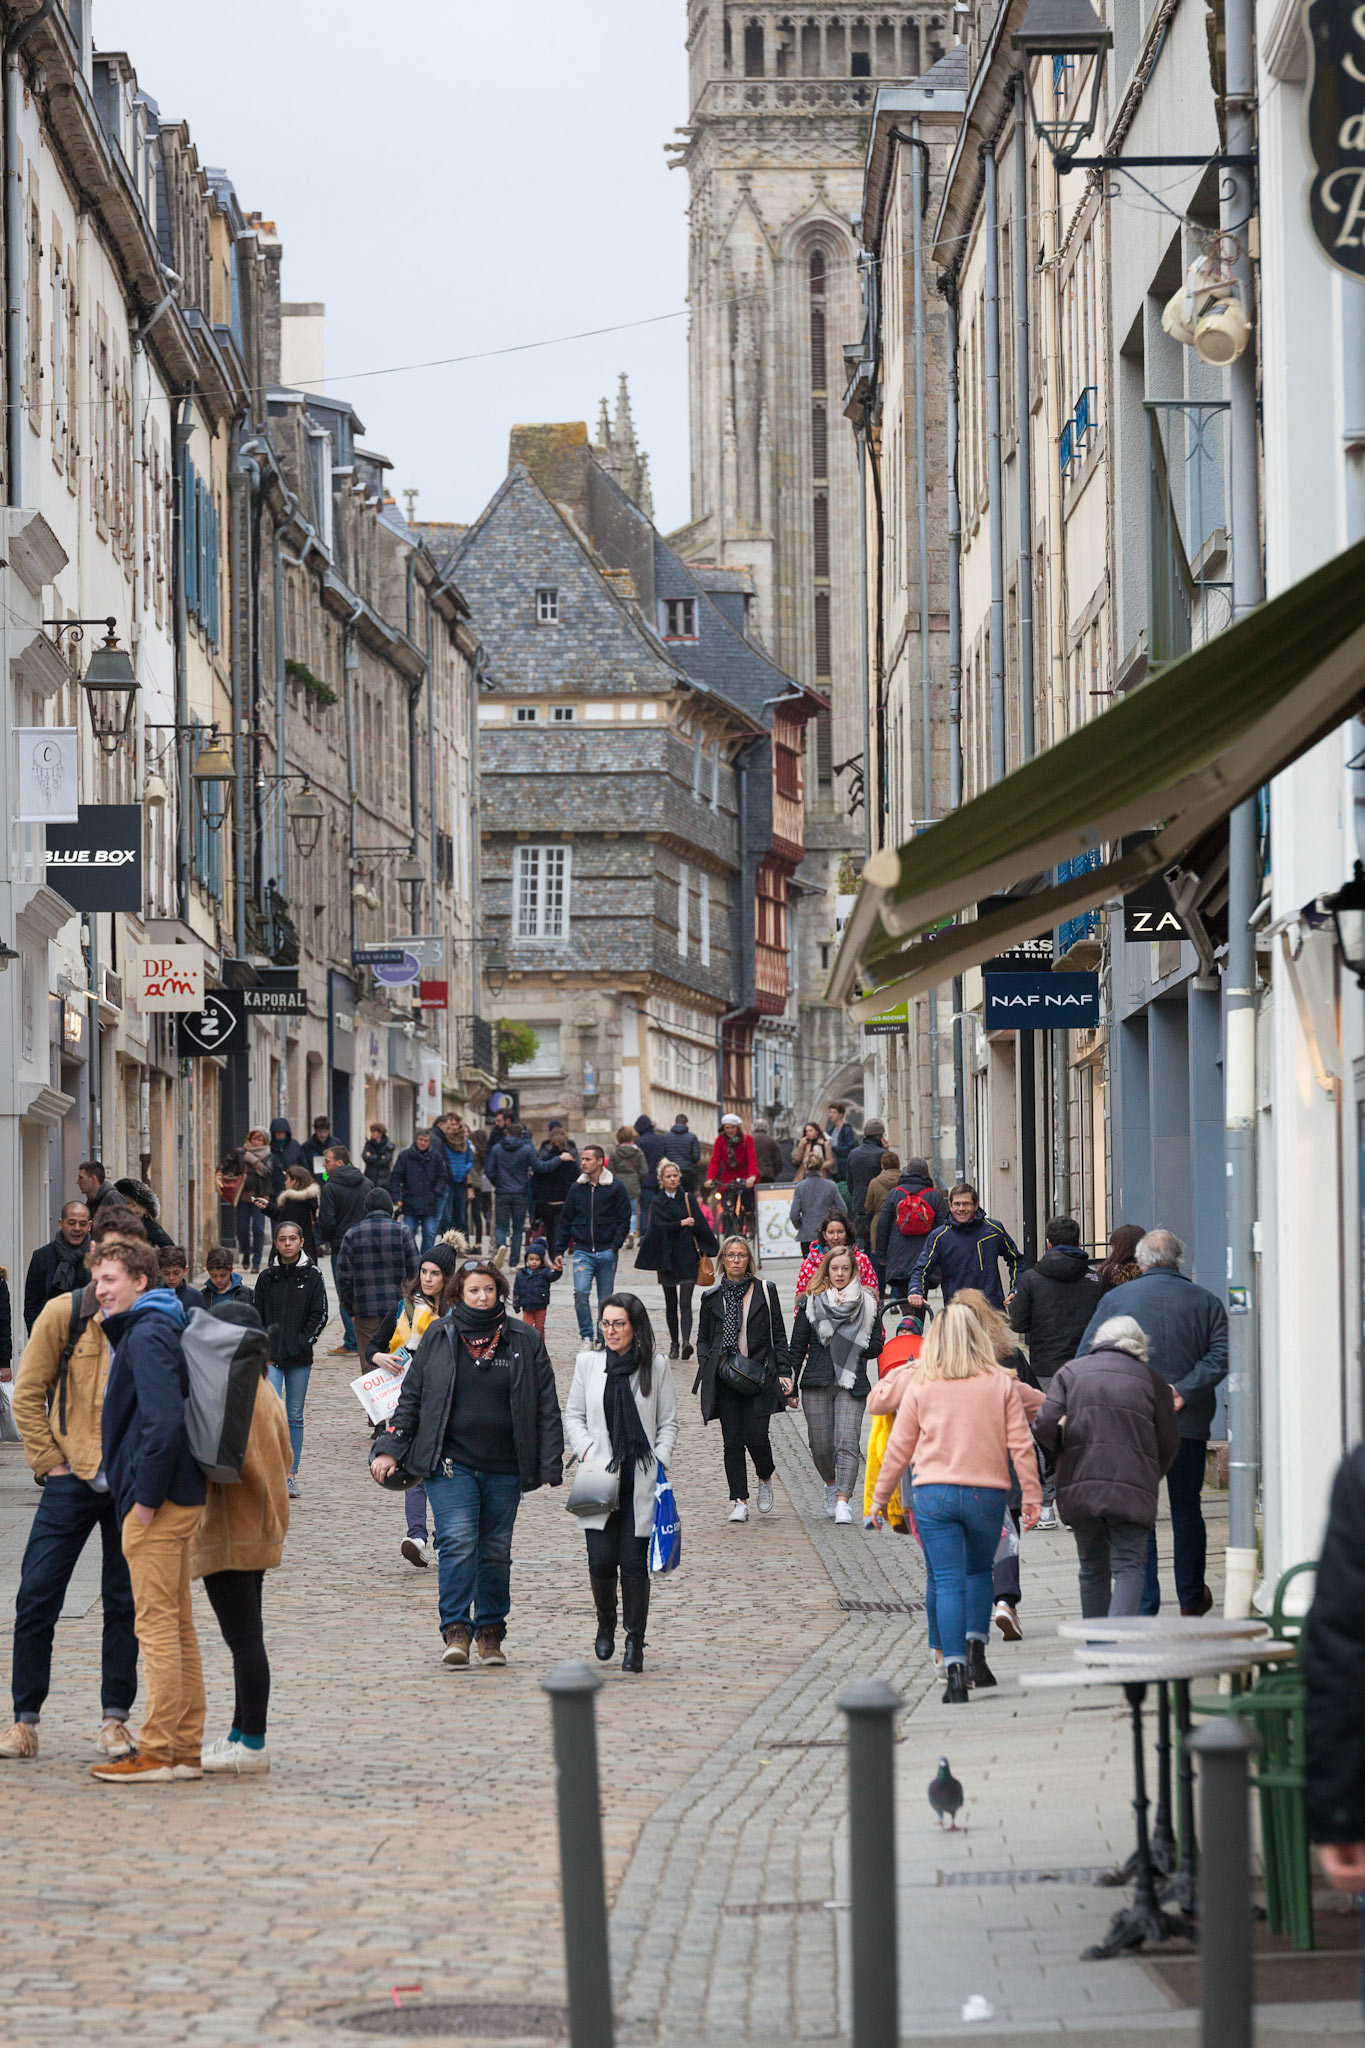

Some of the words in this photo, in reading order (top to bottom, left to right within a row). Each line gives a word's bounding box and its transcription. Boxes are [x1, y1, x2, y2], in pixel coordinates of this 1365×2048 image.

[45, 850, 90, 863] BLUE
[94, 850, 136, 863] BOX
[243, 991, 306, 1008] KAPORAL
[991, 995, 1040, 1007] NAF
[1044, 994, 1093, 1006] NAF
[363, 1375, 385, 1391] OUI
